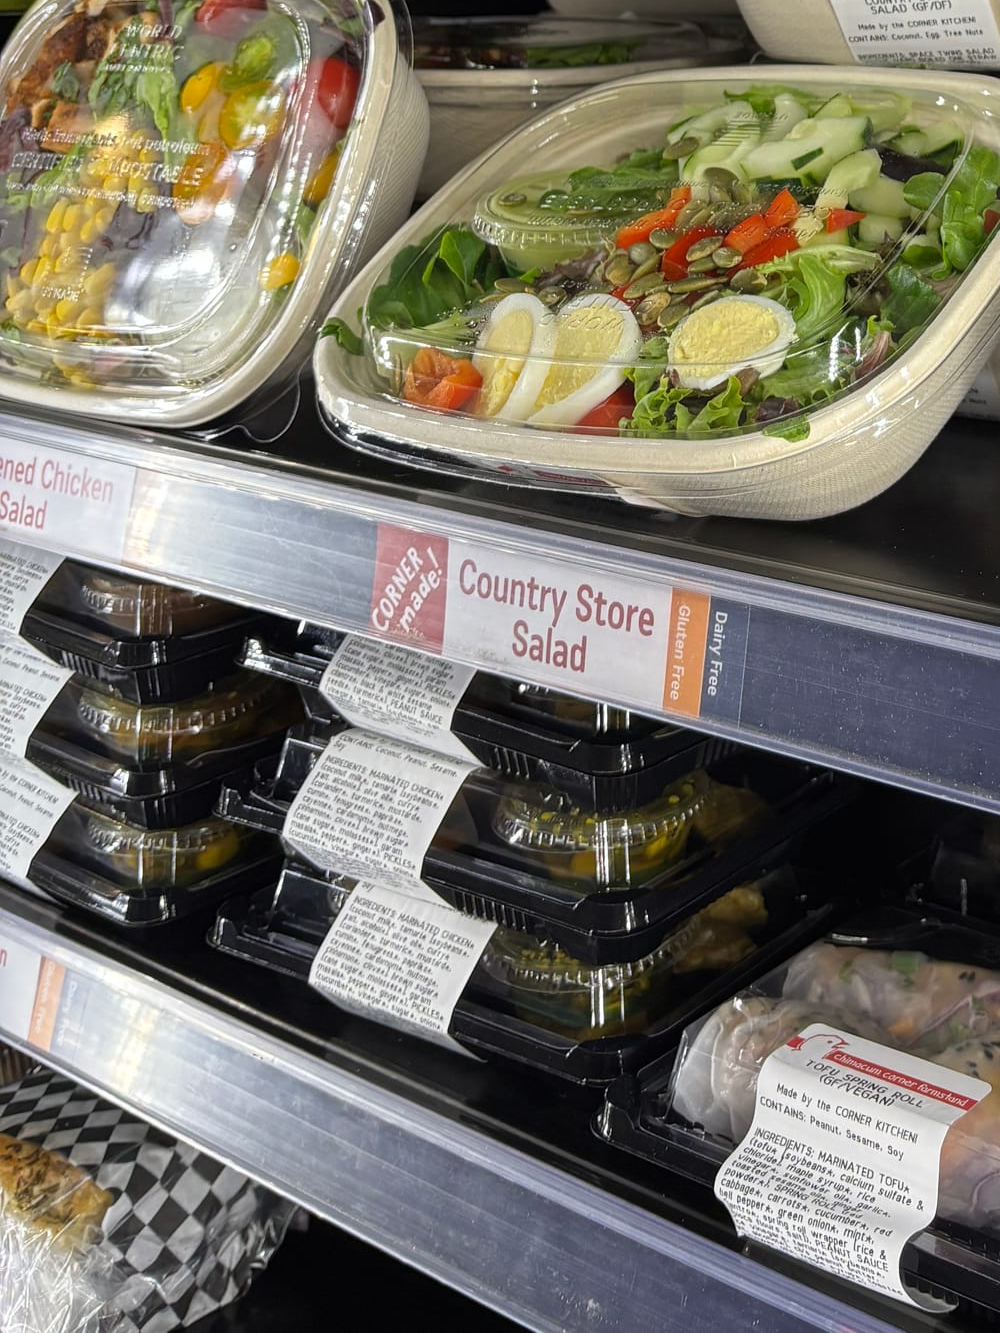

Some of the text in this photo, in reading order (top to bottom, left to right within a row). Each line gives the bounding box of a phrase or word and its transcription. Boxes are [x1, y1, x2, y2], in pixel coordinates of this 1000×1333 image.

[870, 4, 908, 15] SALAD
[41, 459, 114, 504] Chicken
[0, 490, 48, 530] Salad
[371, 546, 424, 633] CORNER
[399, 547, 443, 634] made!
[459, 559, 655, 637] Country Store
[512, 620, 587, 673] Salad
[670, 604, 691, 701] Gluten Free
[707, 610, 728, 697] Dairy Free
[806, 1059, 923, 1109] TOFU SPRING ROLL
[819, 1074, 896, 1107] (GF/VEGAN)
[833, 1053, 970, 1106] chimacum corner farmstand
[759, 1096, 806, 1122] CONTAINS:
[887, 1145, 904, 1162] Soy
[776, 1083, 798, 1100] Made
[801, 1093, 812, 1105] by
[817, 1099, 831, 1112] the
[835, 1105, 873, 1127] CORNER
[754, 1127, 815, 1158] INGREDIENTS:
[818, 1150, 874, 1179] MARINATED
[786, 1164, 814, 1181] maple
[857, 1191, 876, 1204] rice
[840, 1173, 875, 1193] calcium
[878, 1187, 912, 1207] sulfate
[916, 1200, 924, 1211] &
[777, 1209, 804, 1224] green
[873, 1225, 893, 1238] red
